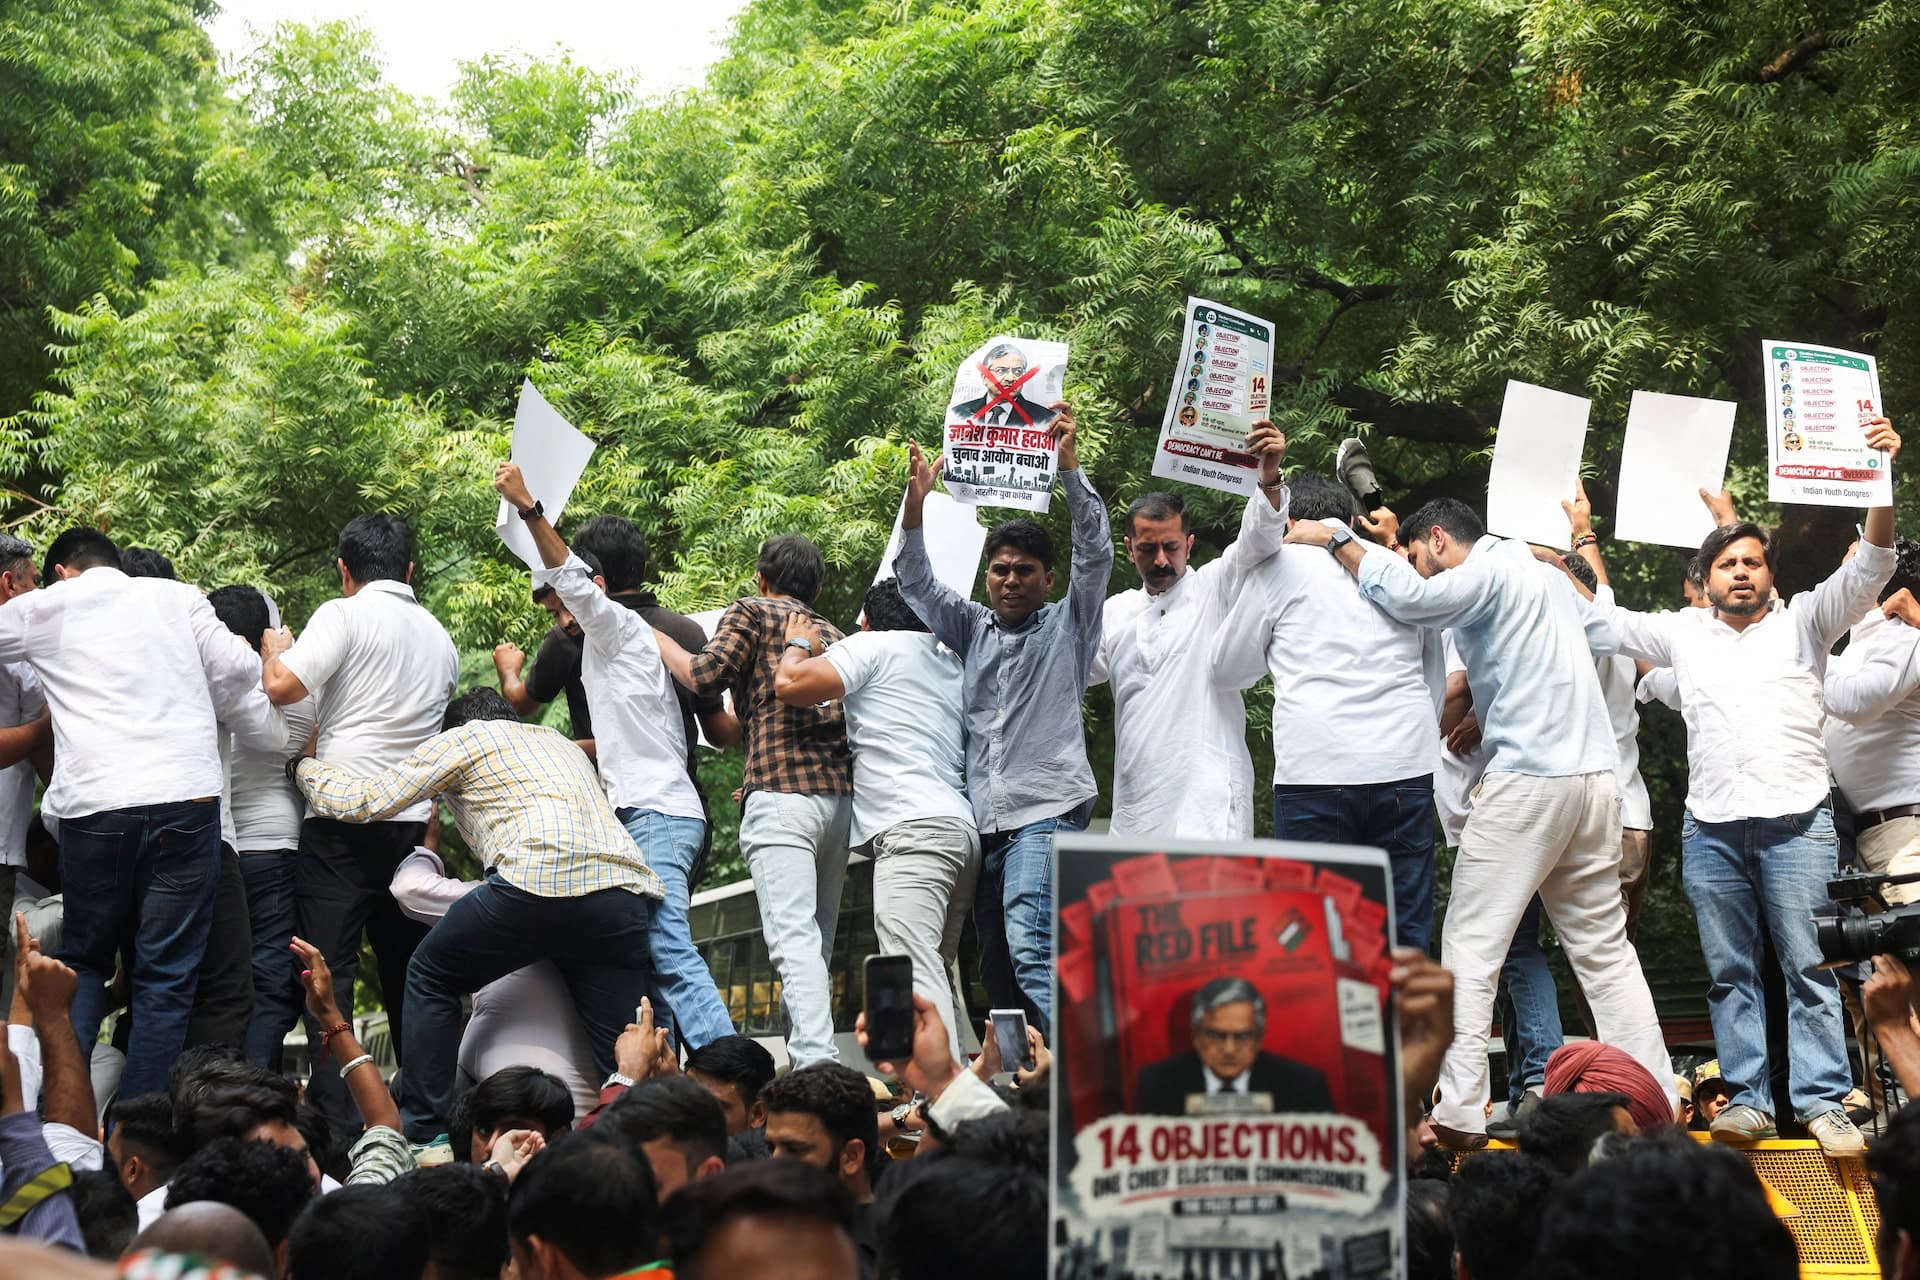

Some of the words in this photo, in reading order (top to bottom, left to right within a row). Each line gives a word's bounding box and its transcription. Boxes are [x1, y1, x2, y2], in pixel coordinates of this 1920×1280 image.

[1252, 377, 1265, 392] 14
[1856, 400, 1873, 412] 14
[949, 420, 986, 442] ज्ञानेश
[986, 426, 1020, 447] कुमार
[952, 447, 980, 464] चुनाव
[982, 449, 1014, 464] आयोग
[1016, 452, 1050, 470] बचाओ
[1167, 440, 1200, 455] DEMOCRACY
[1200, 448, 1216, 458] CAN'T
[1216, 451, 1224, 460] BE
[1182, 464, 1200, 475] Indian
[1201, 466, 1217, 478] Youth
[1217, 472, 1243, 484] Congress
[1779, 467, 1816, 477] DEMOCRACY
[1816, 468, 1833, 478] CAN'T
[1834, 470, 1842, 478] BE
[975, 487, 998, 497] भारतीय
[1000, 490, 1011, 499] युवा
[1803, 486, 1822, 495] Indian
[1824, 488, 1842, 496] Youth
[1136, 902, 1183, 928] THE
[1134, 928, 1192, 968] RED
[1200, 917, 1258, 959] FILE
[1098, 1124, 1142, 1170] 14
[1150, 1122, 1367, 1164] OBJECTIONS.
[1092, 1173, 1120, 1198] ONE
[1126, 1167, 1170, 1191] CHIEF
[1177, 1164, 1248, 1187] ELECTION
